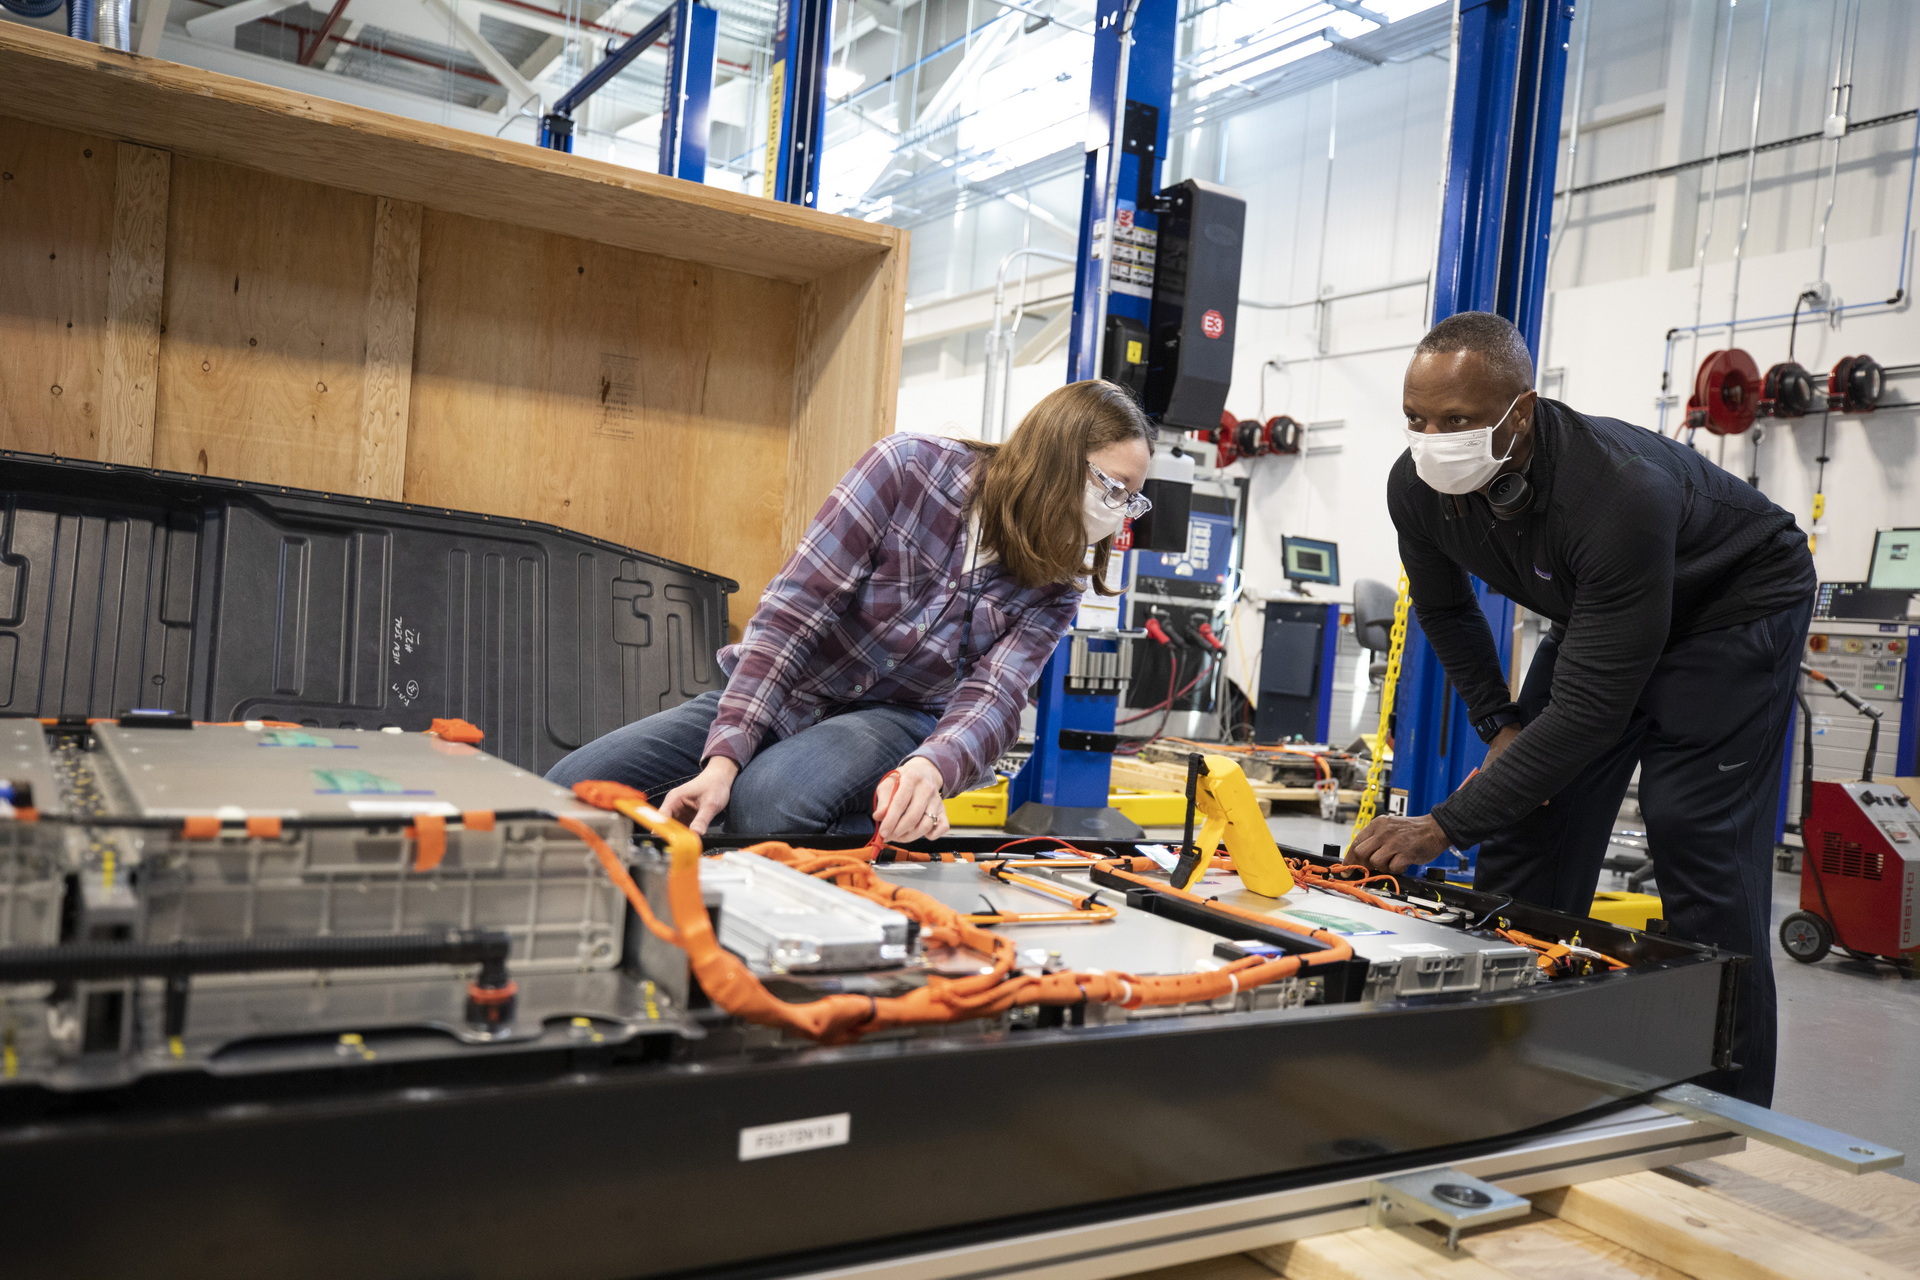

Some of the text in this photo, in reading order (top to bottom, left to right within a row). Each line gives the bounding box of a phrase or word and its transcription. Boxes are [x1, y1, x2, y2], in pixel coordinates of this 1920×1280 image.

[1204, 316, 1223, 333] E3
[1116, 531, 1131, 545] H1
[392, 615, 403, 665] NEW SEAL
